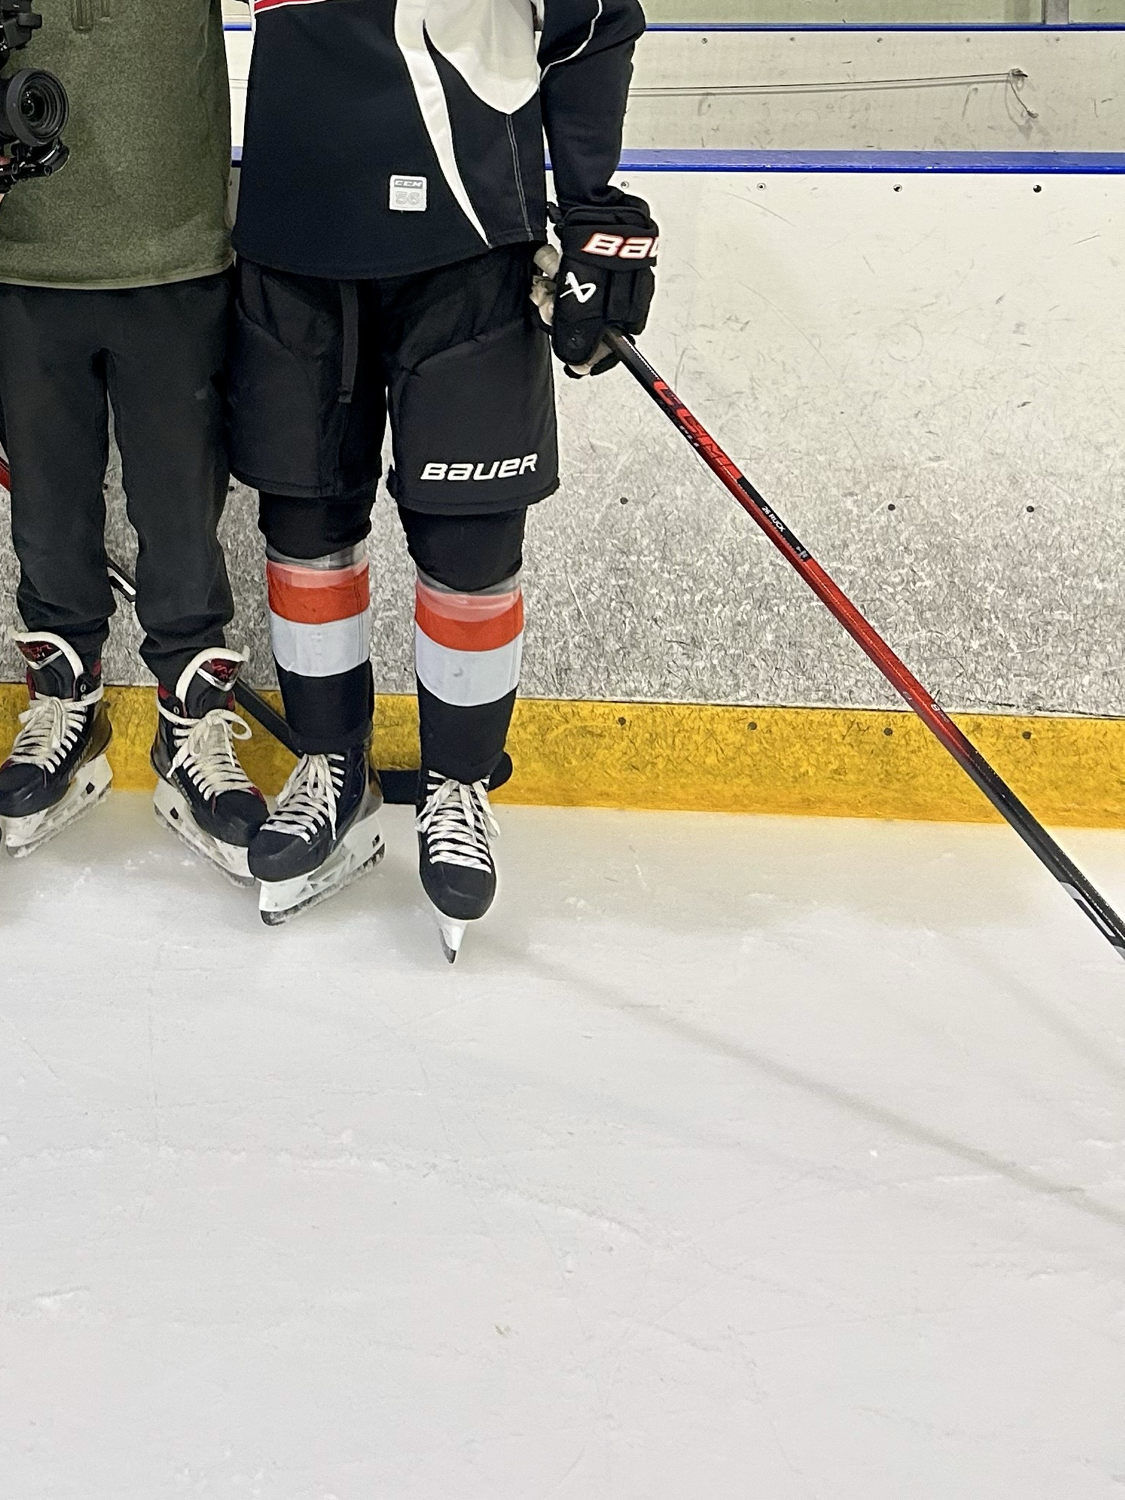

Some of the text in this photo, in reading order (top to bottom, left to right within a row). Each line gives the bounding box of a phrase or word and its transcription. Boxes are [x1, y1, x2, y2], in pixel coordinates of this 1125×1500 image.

[394, 180, 423, 188] CCM
[395, 190, 421, 206] 56
[768, 513, 786, 533] RUCK
